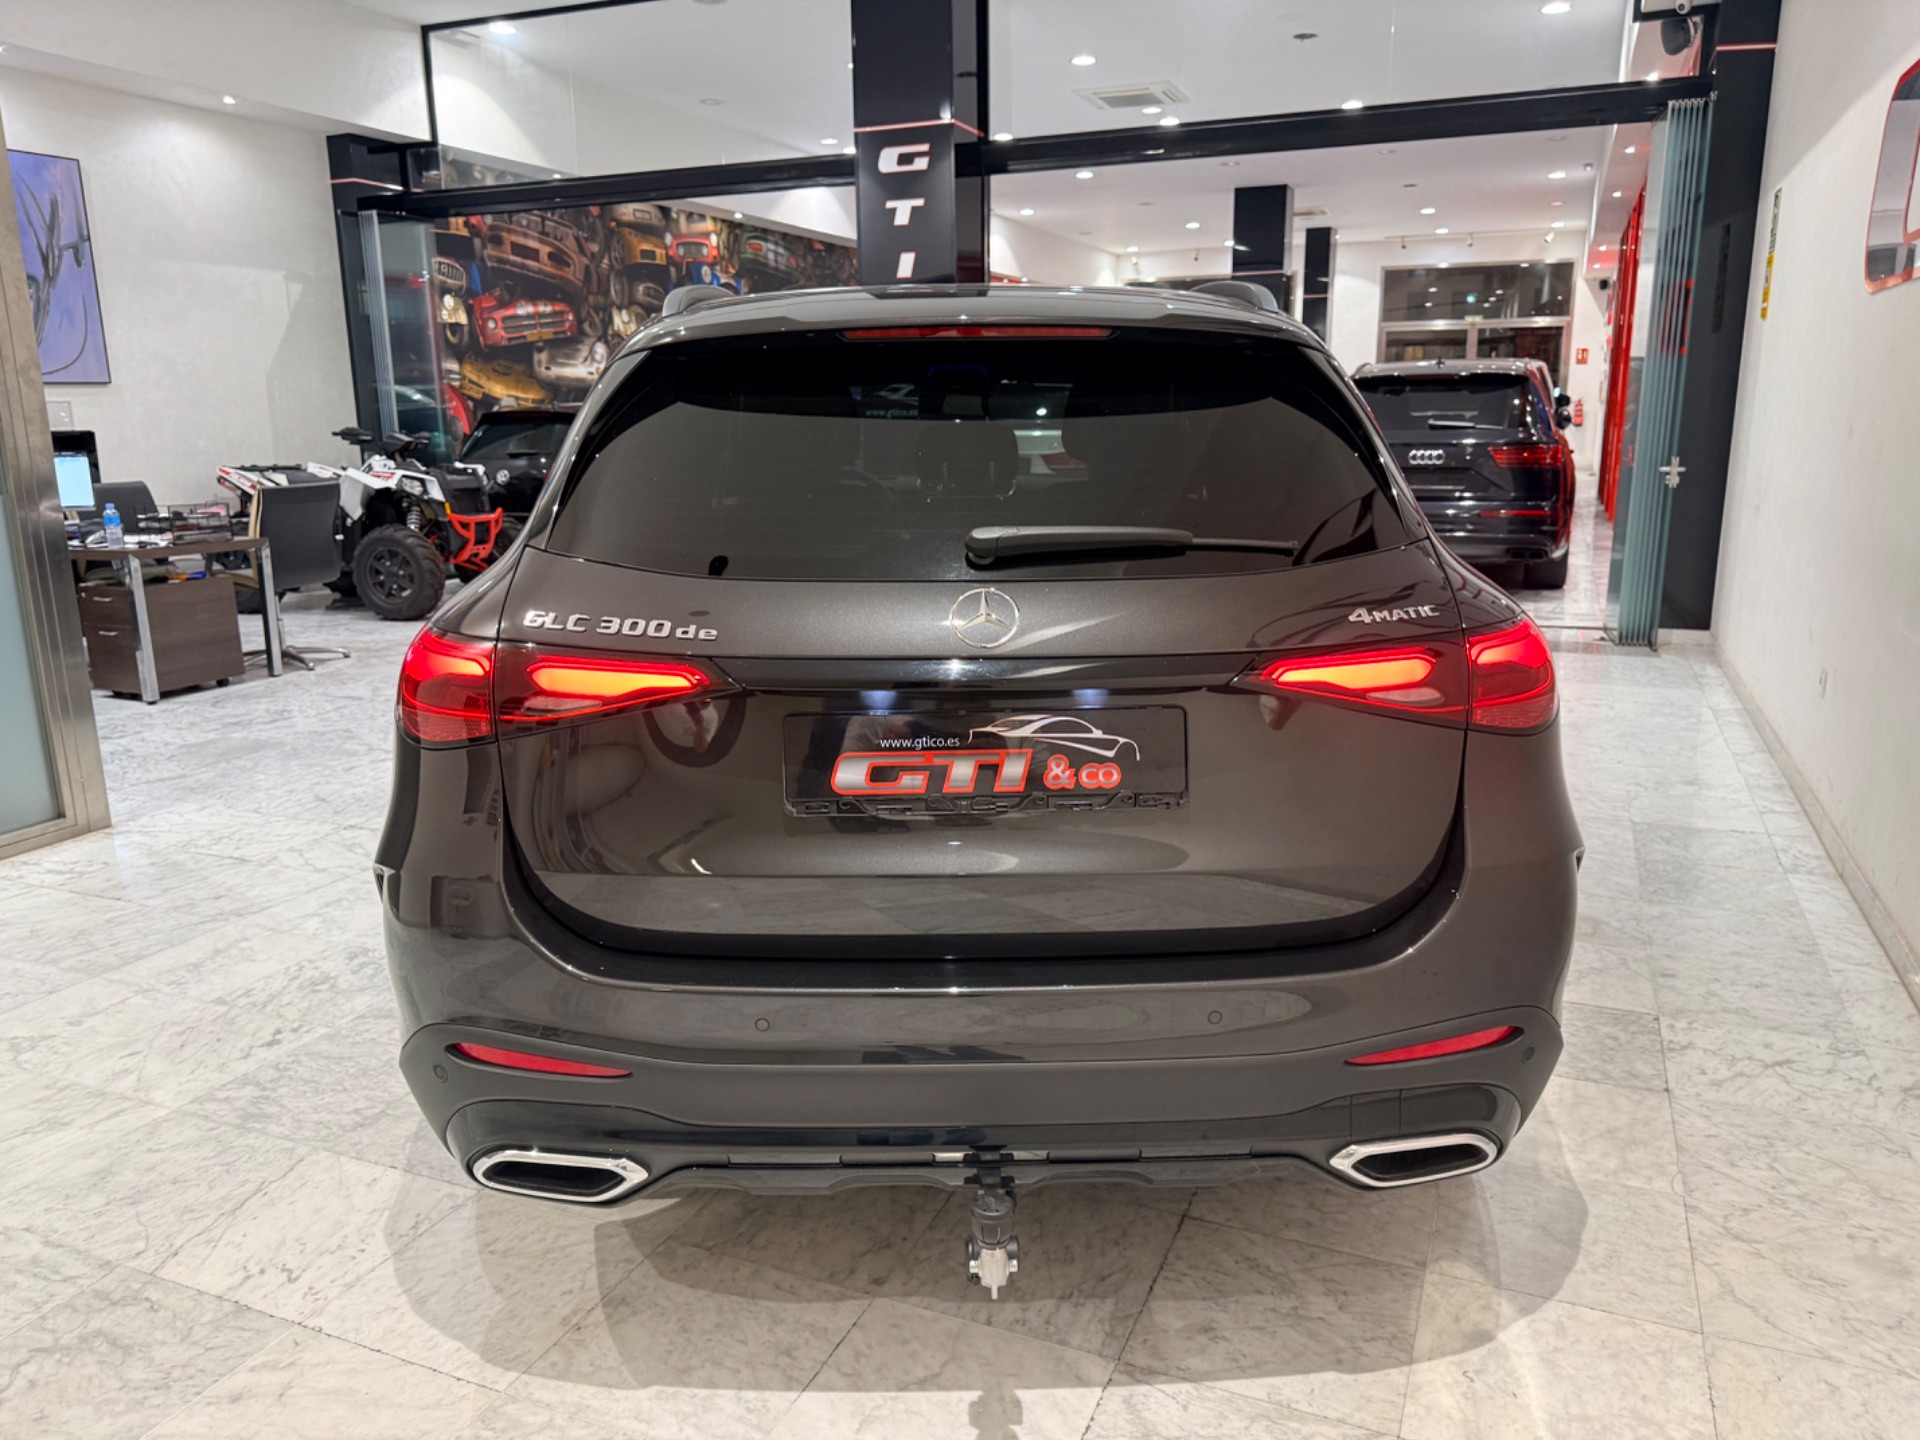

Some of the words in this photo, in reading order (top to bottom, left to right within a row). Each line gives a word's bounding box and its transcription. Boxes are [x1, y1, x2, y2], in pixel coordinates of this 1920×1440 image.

[877, 142, 931, 279] GTI
[522, 610, 590, 632] GLC
[596, 616, 671, 637] 300
[675, 624, 718, 640] de
[1348, 605, 1440, 624] 4MATIC
[879, 735, 961, 750] www.gtico.es
[831, 748, 1033, 795] GTI
